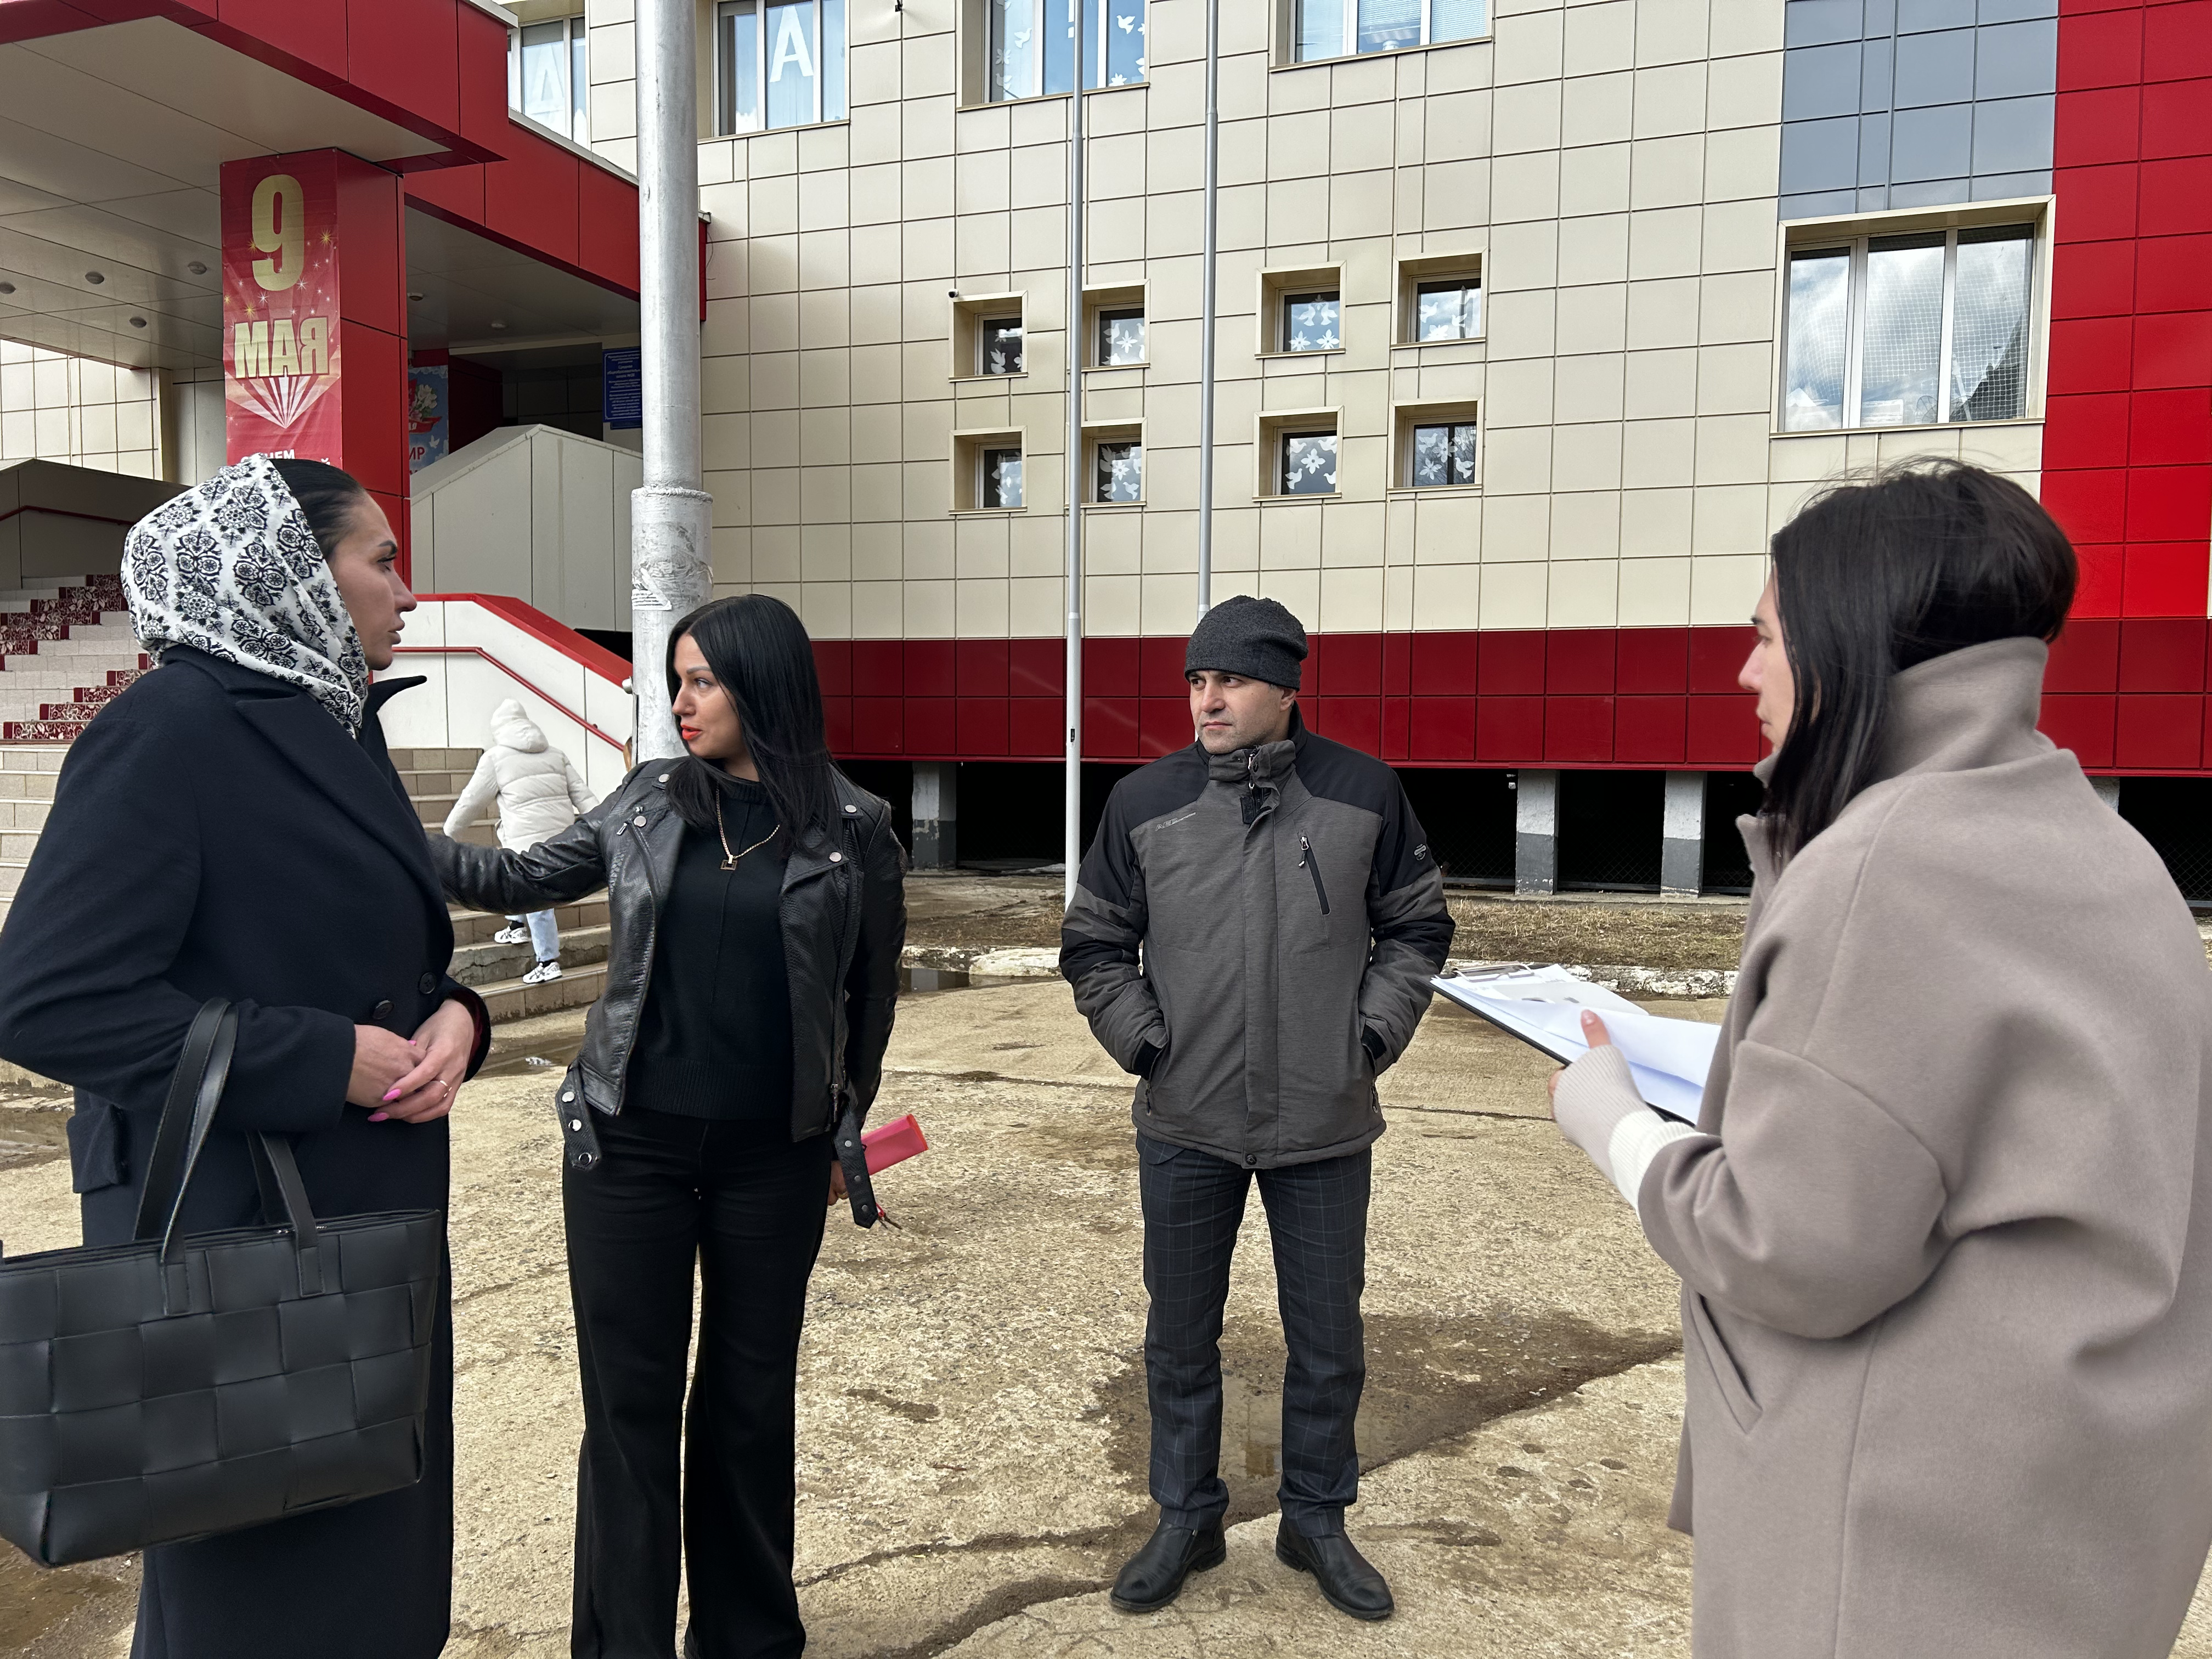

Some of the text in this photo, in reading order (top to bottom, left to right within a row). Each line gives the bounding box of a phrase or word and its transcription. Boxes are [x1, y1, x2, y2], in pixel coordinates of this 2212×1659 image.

[769, 5, 814, 83] А
[252, 174, 304, 291] 9
[234, 317, 330, 379] МАЯ
[409, 447, 425, 460] ИР
